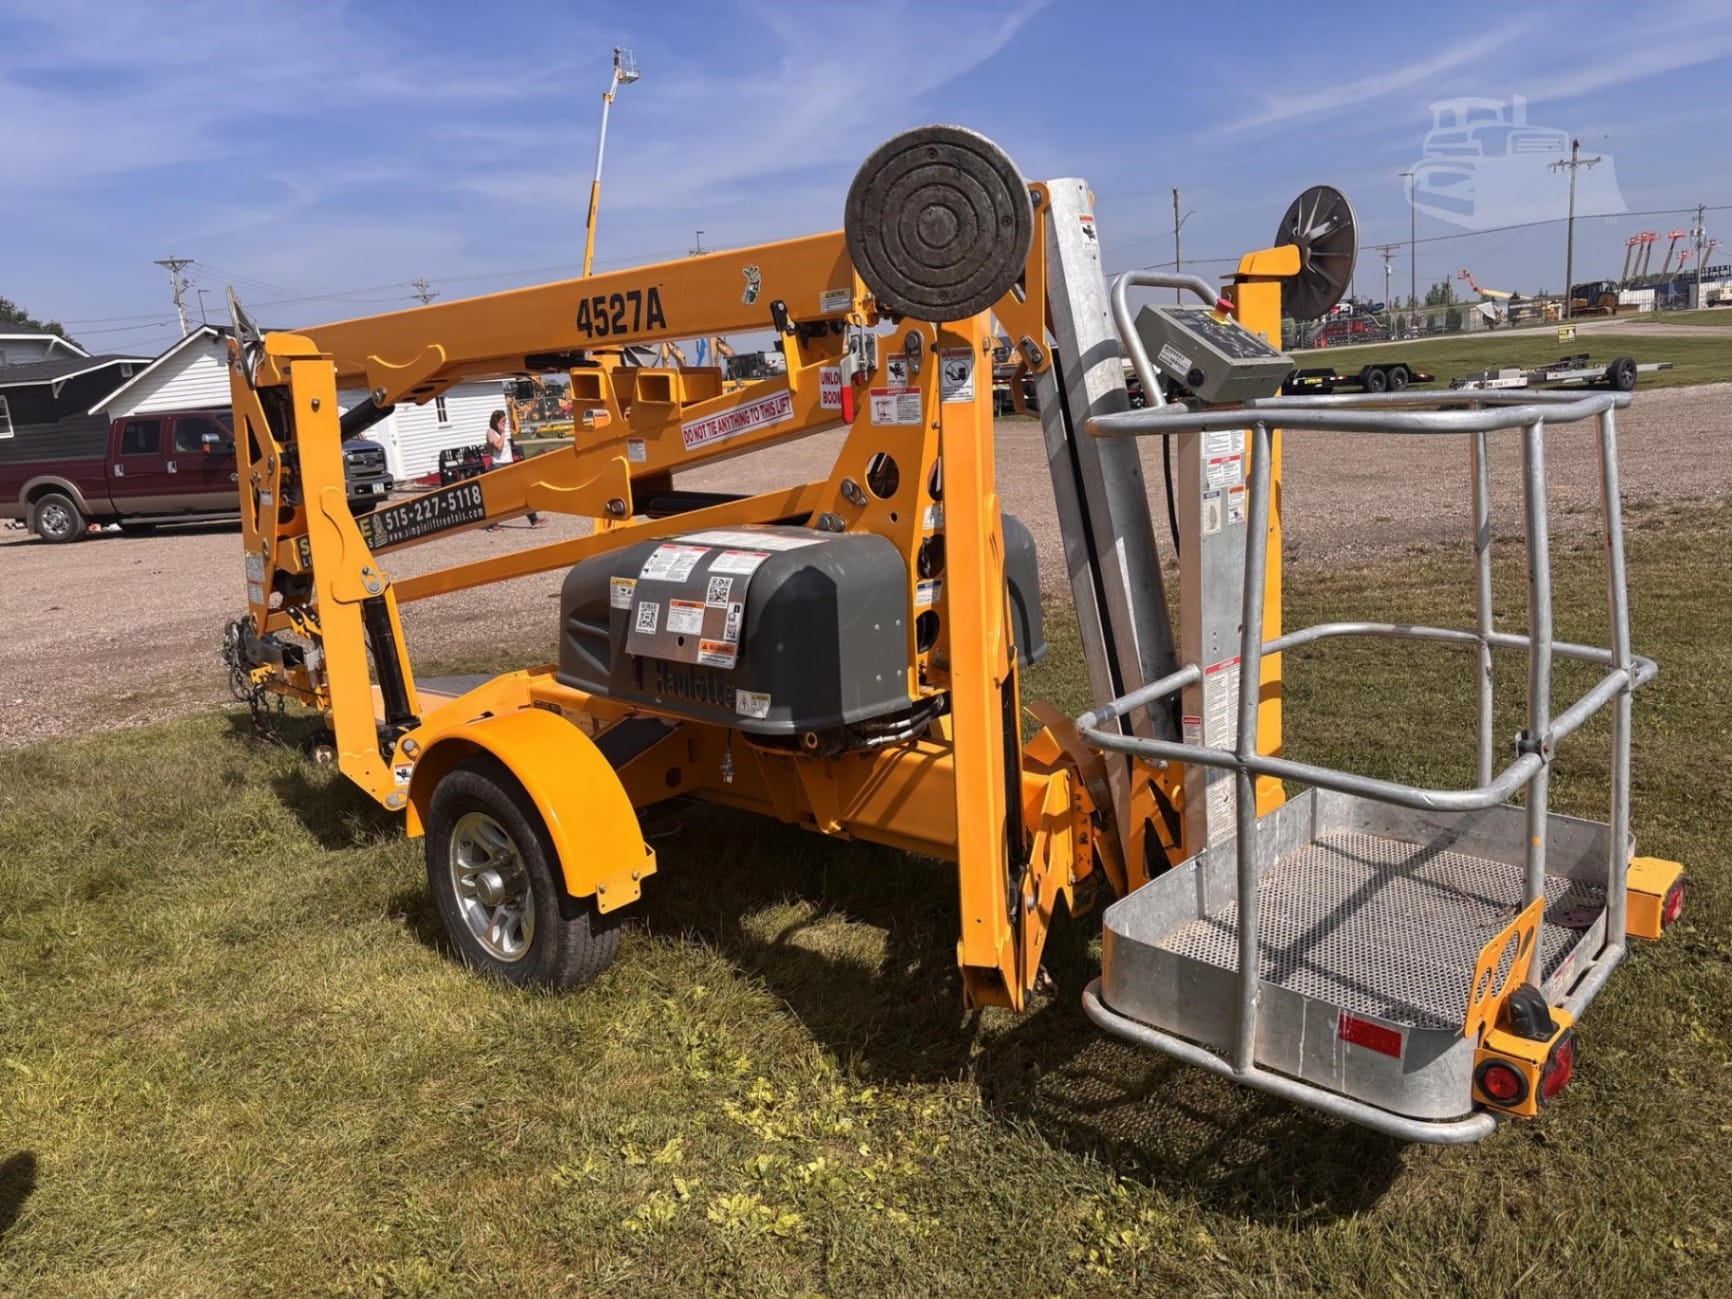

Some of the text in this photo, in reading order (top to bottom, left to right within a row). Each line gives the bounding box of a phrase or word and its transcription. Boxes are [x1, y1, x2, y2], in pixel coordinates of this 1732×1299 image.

[577, 287, 667, 338] 4527A
[821, 372, 842, 386] UNLO
[684, 396, 792, 444] DO NOT TIE ANYTHING TO THIS LIFT
[385, 485, 481, 530] 515-227-5118
[389, 508, 484, 541] www.simpleliftrentals.com
